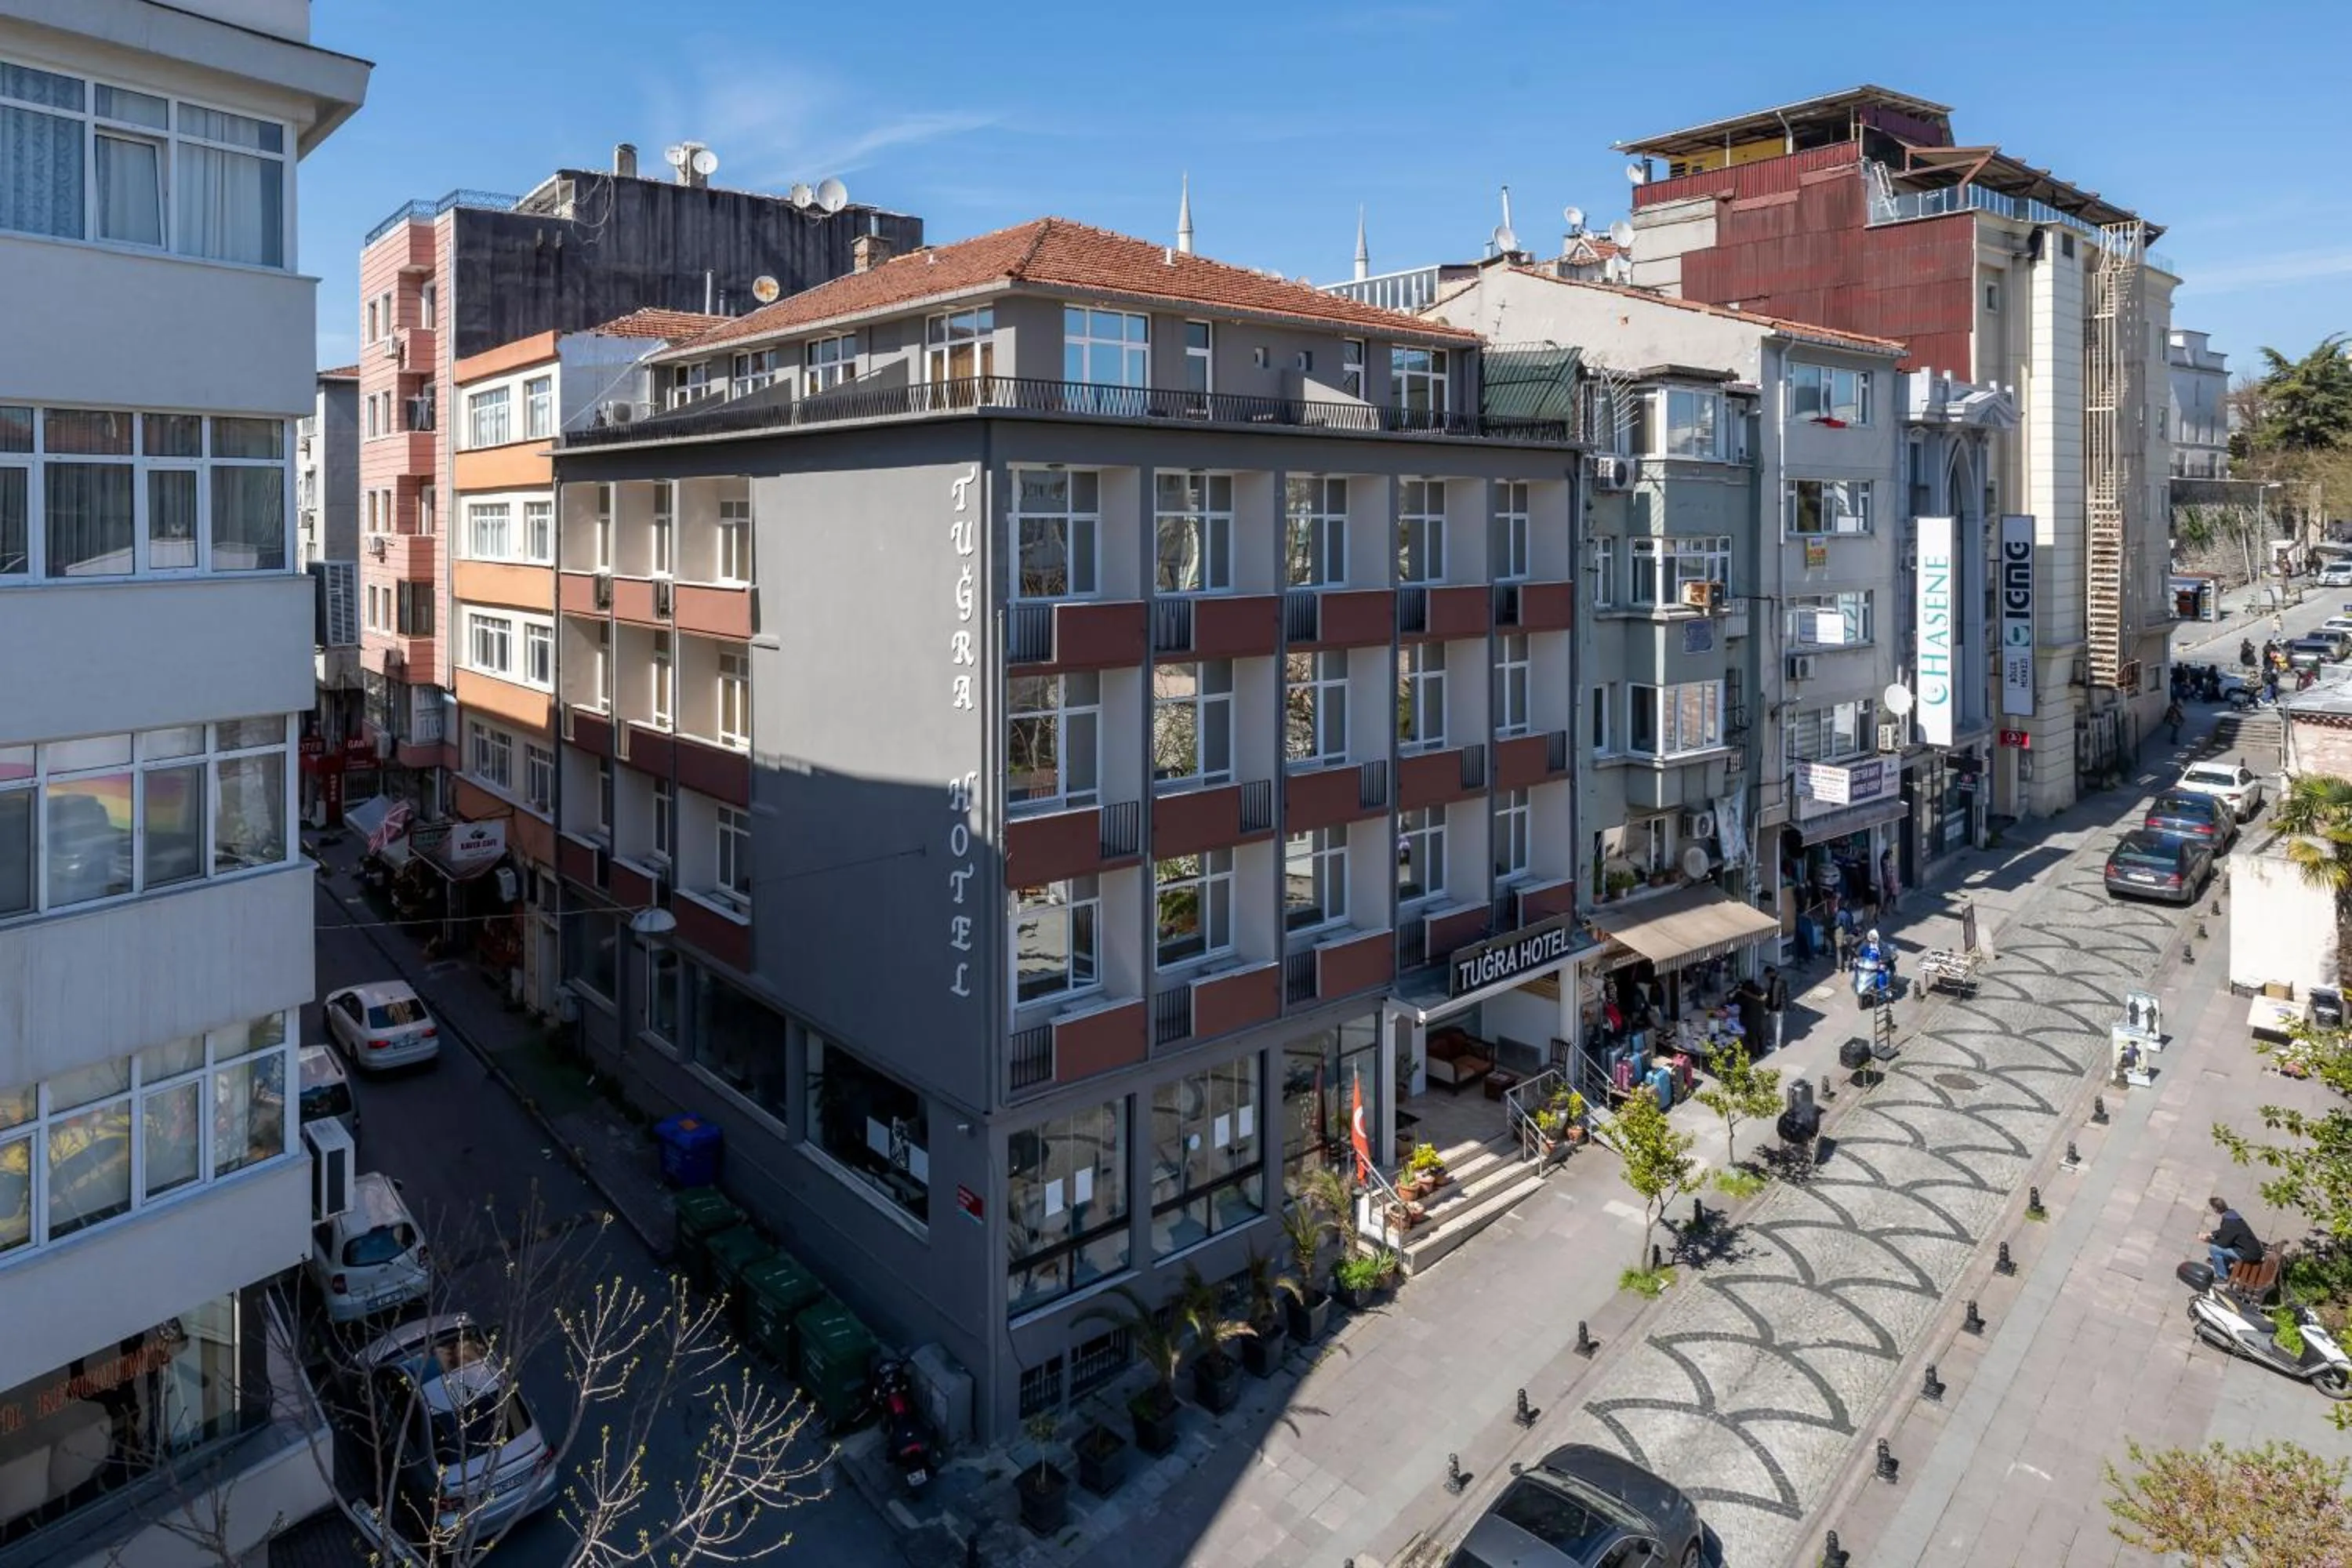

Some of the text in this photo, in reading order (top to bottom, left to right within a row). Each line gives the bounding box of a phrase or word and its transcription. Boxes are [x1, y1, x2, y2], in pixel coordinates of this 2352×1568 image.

[1921, 555, 1949, 677] HASENE
[949, 465, 978, 997] TUĞRA HOTEL
[1459, 927, 1569, 991] TUĞRA HOTEL
